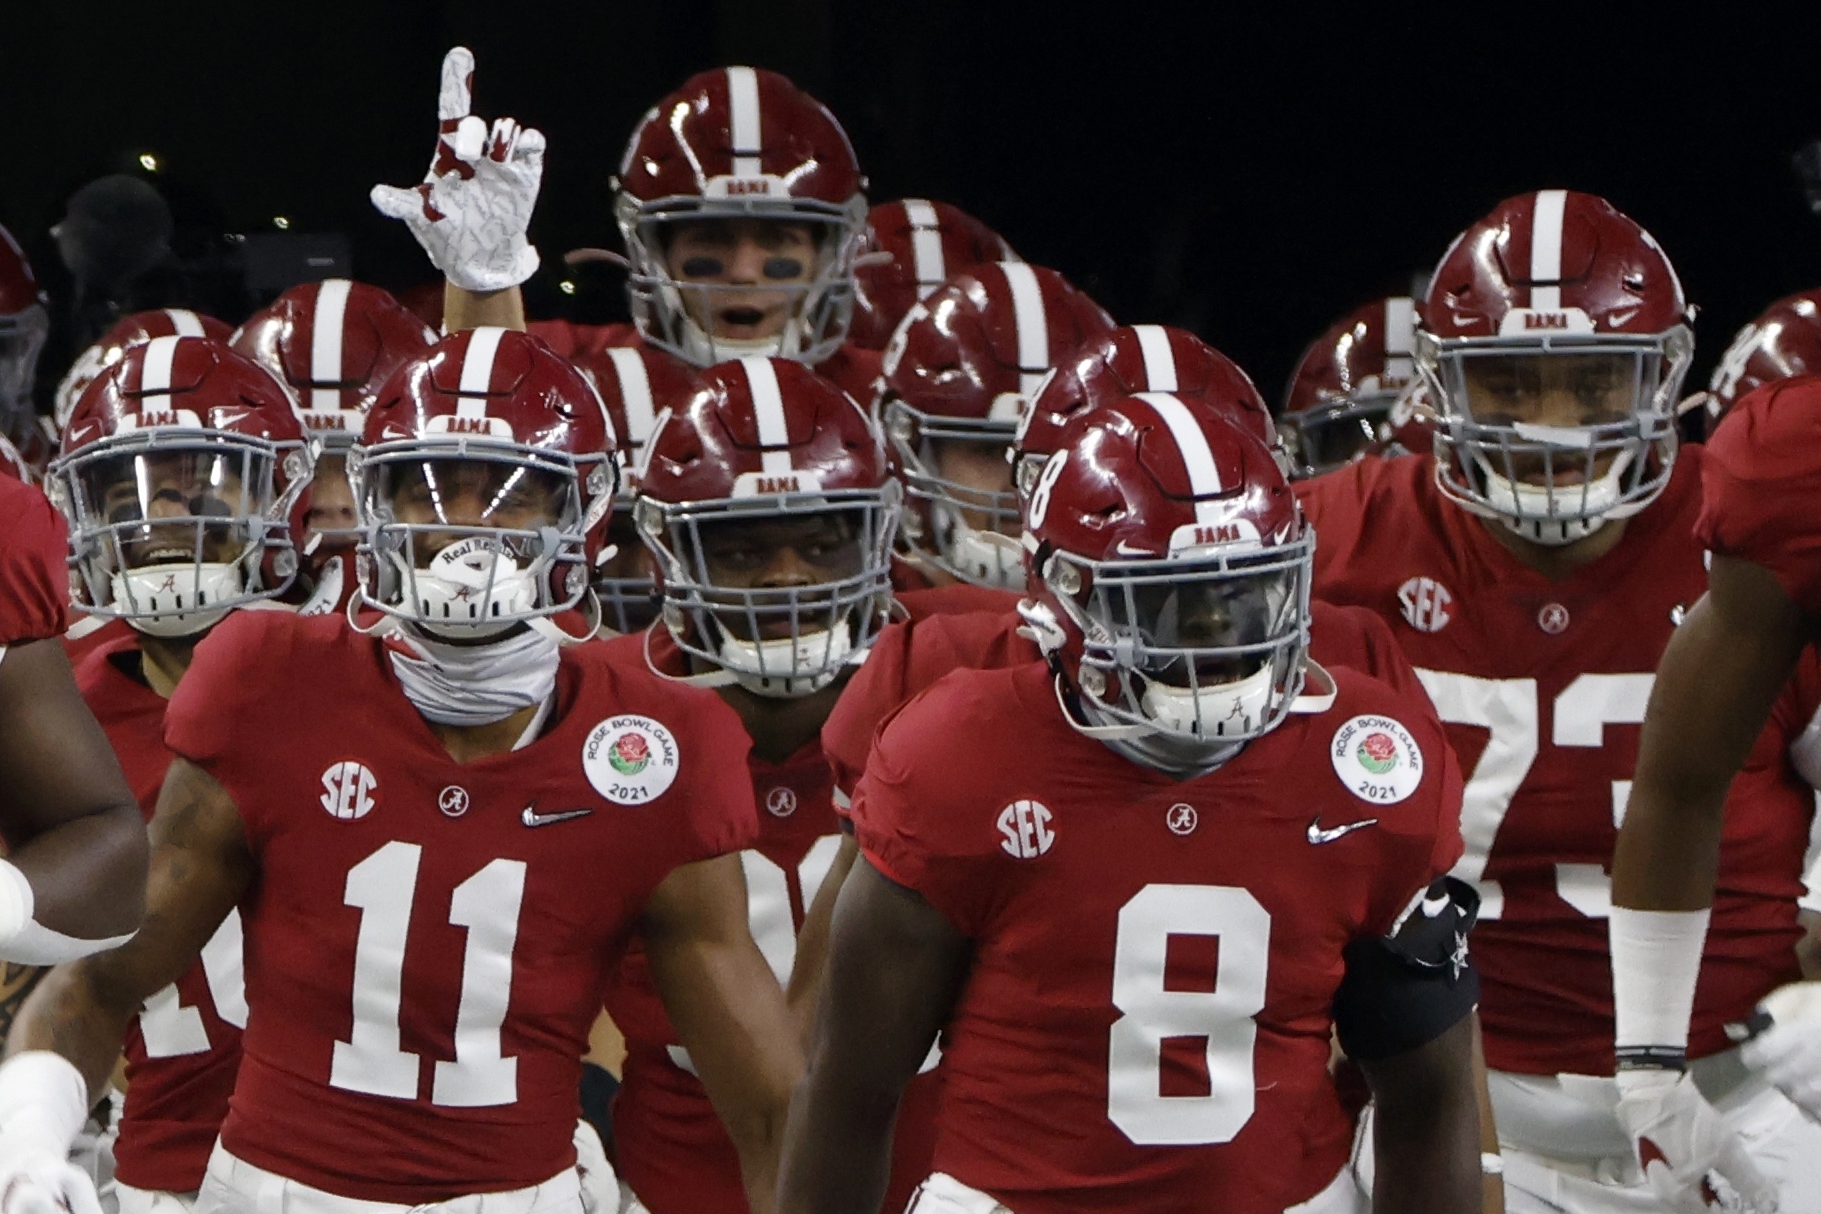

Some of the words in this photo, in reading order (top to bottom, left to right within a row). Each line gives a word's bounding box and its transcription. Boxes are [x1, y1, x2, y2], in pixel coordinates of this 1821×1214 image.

[1524, 312, 1568, 329] BAMA
[136, 410, 179, 428] BAMA
[304, 414, 346, 430] BAMA
[447, 417, 491, 434] BAMA
[756, 477, 800, 494] BAMA
[1030, 449, 1068, 530] 8
[1195, 524, 1240, 545] BAMA
[441, 541, 472, 565] Real
[1397, 576, 1452, 634] SEC
[587, 726, 610, 761] ROSE
[612, 718, 653, 733] BOWL
[653, 729, 674, 767] GAME
[1336, 725, 1357, 758] ROSE
[1358, 718, 1398, 735] BOWL
[1398, 732, 1419, 771] GAME
[319, 760, 377, 819] SEC
[608, 783, 649, 800] 2021
[1359, 781, 1397, 799] 2021
[996, 800, 1056, 859] SEC
[329, 841, 527, 1107] 11
[1107, 883, 1271, 1146] 8
